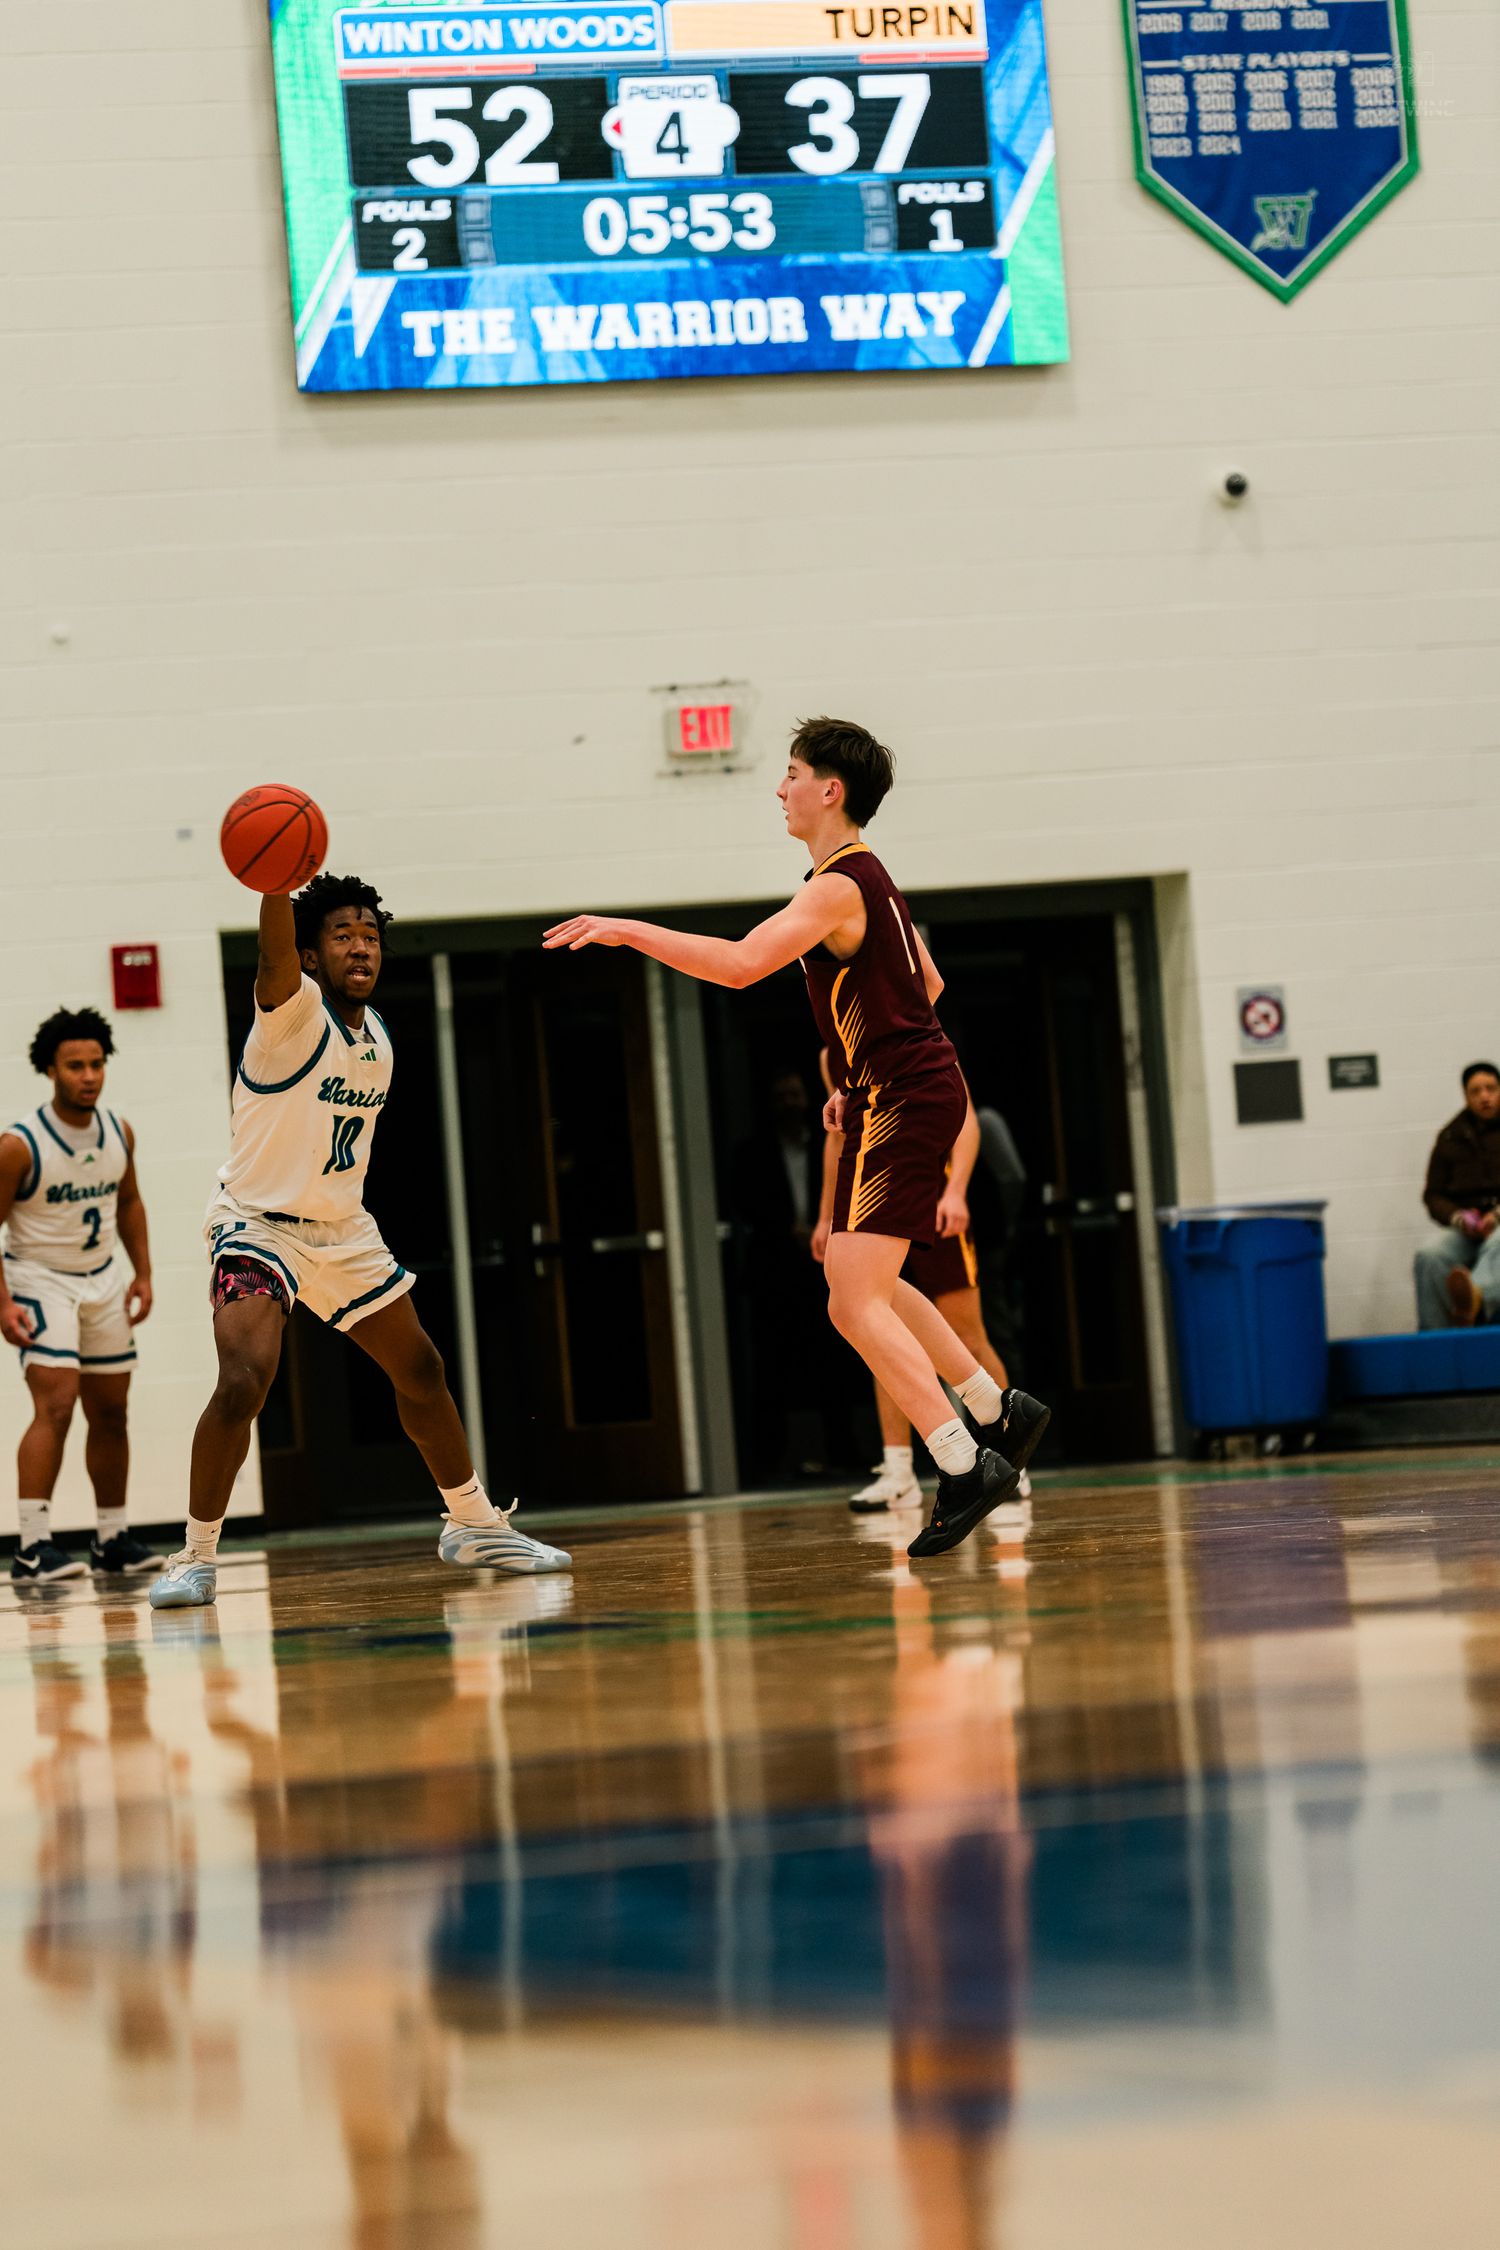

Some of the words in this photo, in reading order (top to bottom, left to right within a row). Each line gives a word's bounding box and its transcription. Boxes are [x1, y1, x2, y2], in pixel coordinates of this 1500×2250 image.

[343, 19, 503, 53] WINTON
[509, 14, 657, 48] WOODS
[825, 6, 975, 40] TURPIN
[1181, 53, 1243, 71] STATE
[1247, 50, 1350, 69] PLAYOFFS
[628, 83, 711, 102] PERIOD
[407, 86, 560, 187] 52
[656, 111, 691, 164] 4
[784, 74, 932, 176] 37
[362, 199, 452, 223] FOULS
[898, 180, 986, 205] FOULS
[583, 192, 777, 255] 05:53
[929, 209, 964, 253] 1
[392, 227, 429, 272] 2
[402, 309, 518, 357] THE
[535, 298, 809, 353] WARRIOR
[822, 291, 966, 340] WAY
[679, 703, 733, 752] EXIT
[317, 1076, 388, 1108] Warrio
[321, 1114, 365, 1176] 10
[81, 1207, 102, 1251] 2
